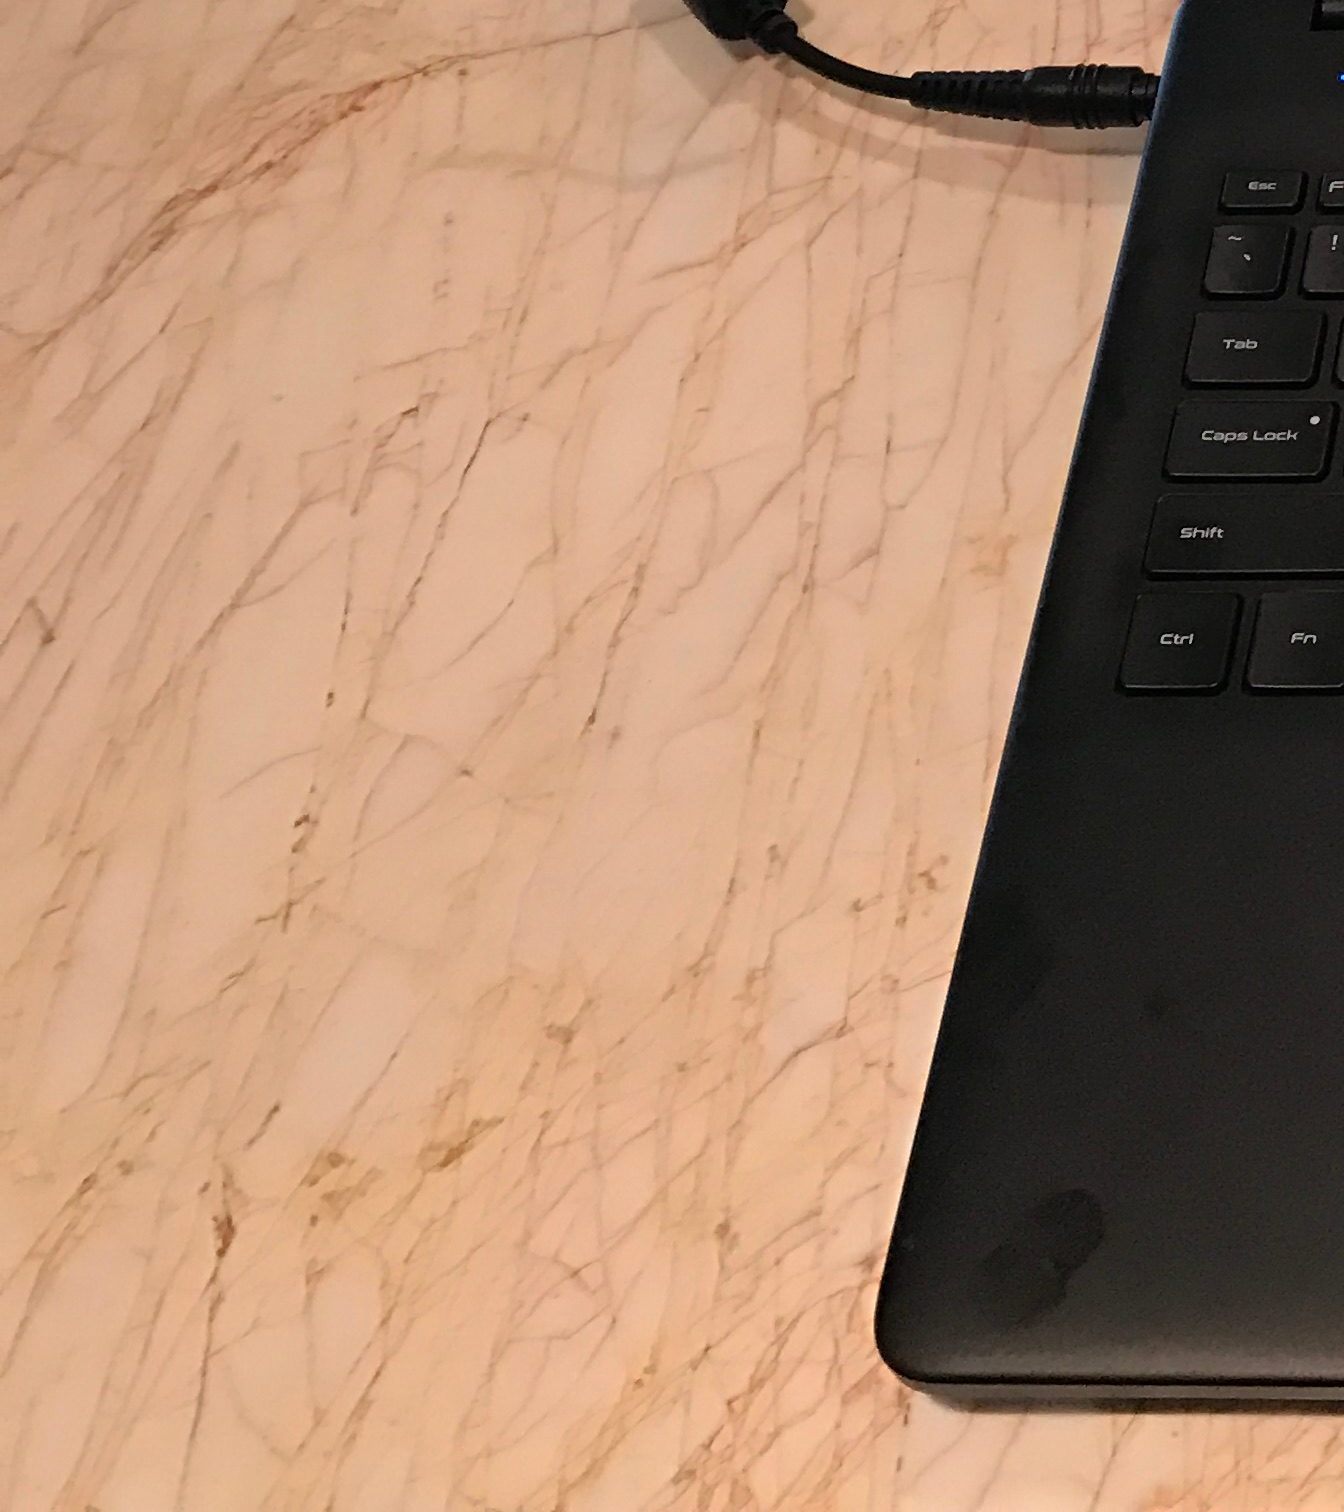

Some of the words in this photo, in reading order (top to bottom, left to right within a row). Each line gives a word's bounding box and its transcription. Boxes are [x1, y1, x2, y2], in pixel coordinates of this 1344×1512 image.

[1248, 181, 1277, 191] Esc
[1222, 338, 1258, 350] Tab
[1201, 429, 1249, 444] Caps
[1252, 429, 1299, 441] Lock
[1179, 526, 1225, 539] Shift
[1159, 632, 1194, 645] Ctrl
[1290, 632, 1317, 644] Fn
